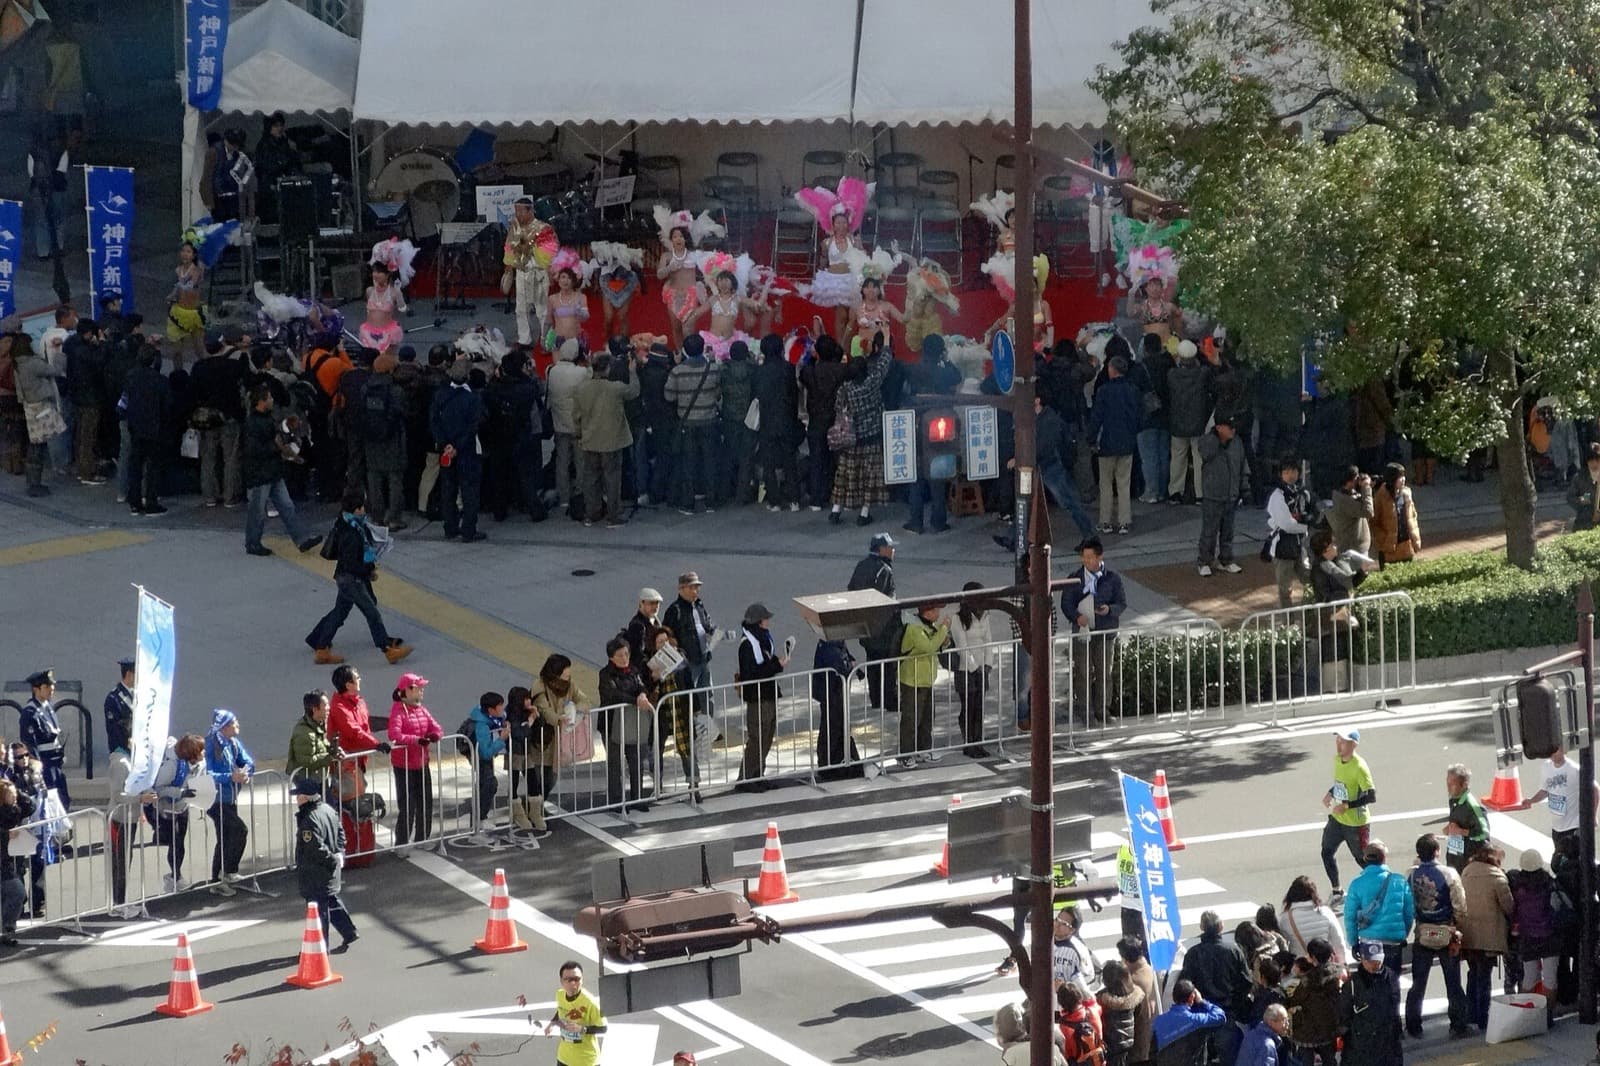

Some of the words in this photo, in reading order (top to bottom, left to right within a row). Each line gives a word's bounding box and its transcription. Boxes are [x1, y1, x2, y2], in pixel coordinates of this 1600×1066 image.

[196, 15, 220, 94] 神戸新聞
[0, 258, 12, 319] 神戸
[892, 415, 908, 479] 歩車分離式
[1143, 842, 1175, 943] 神戸新聞
